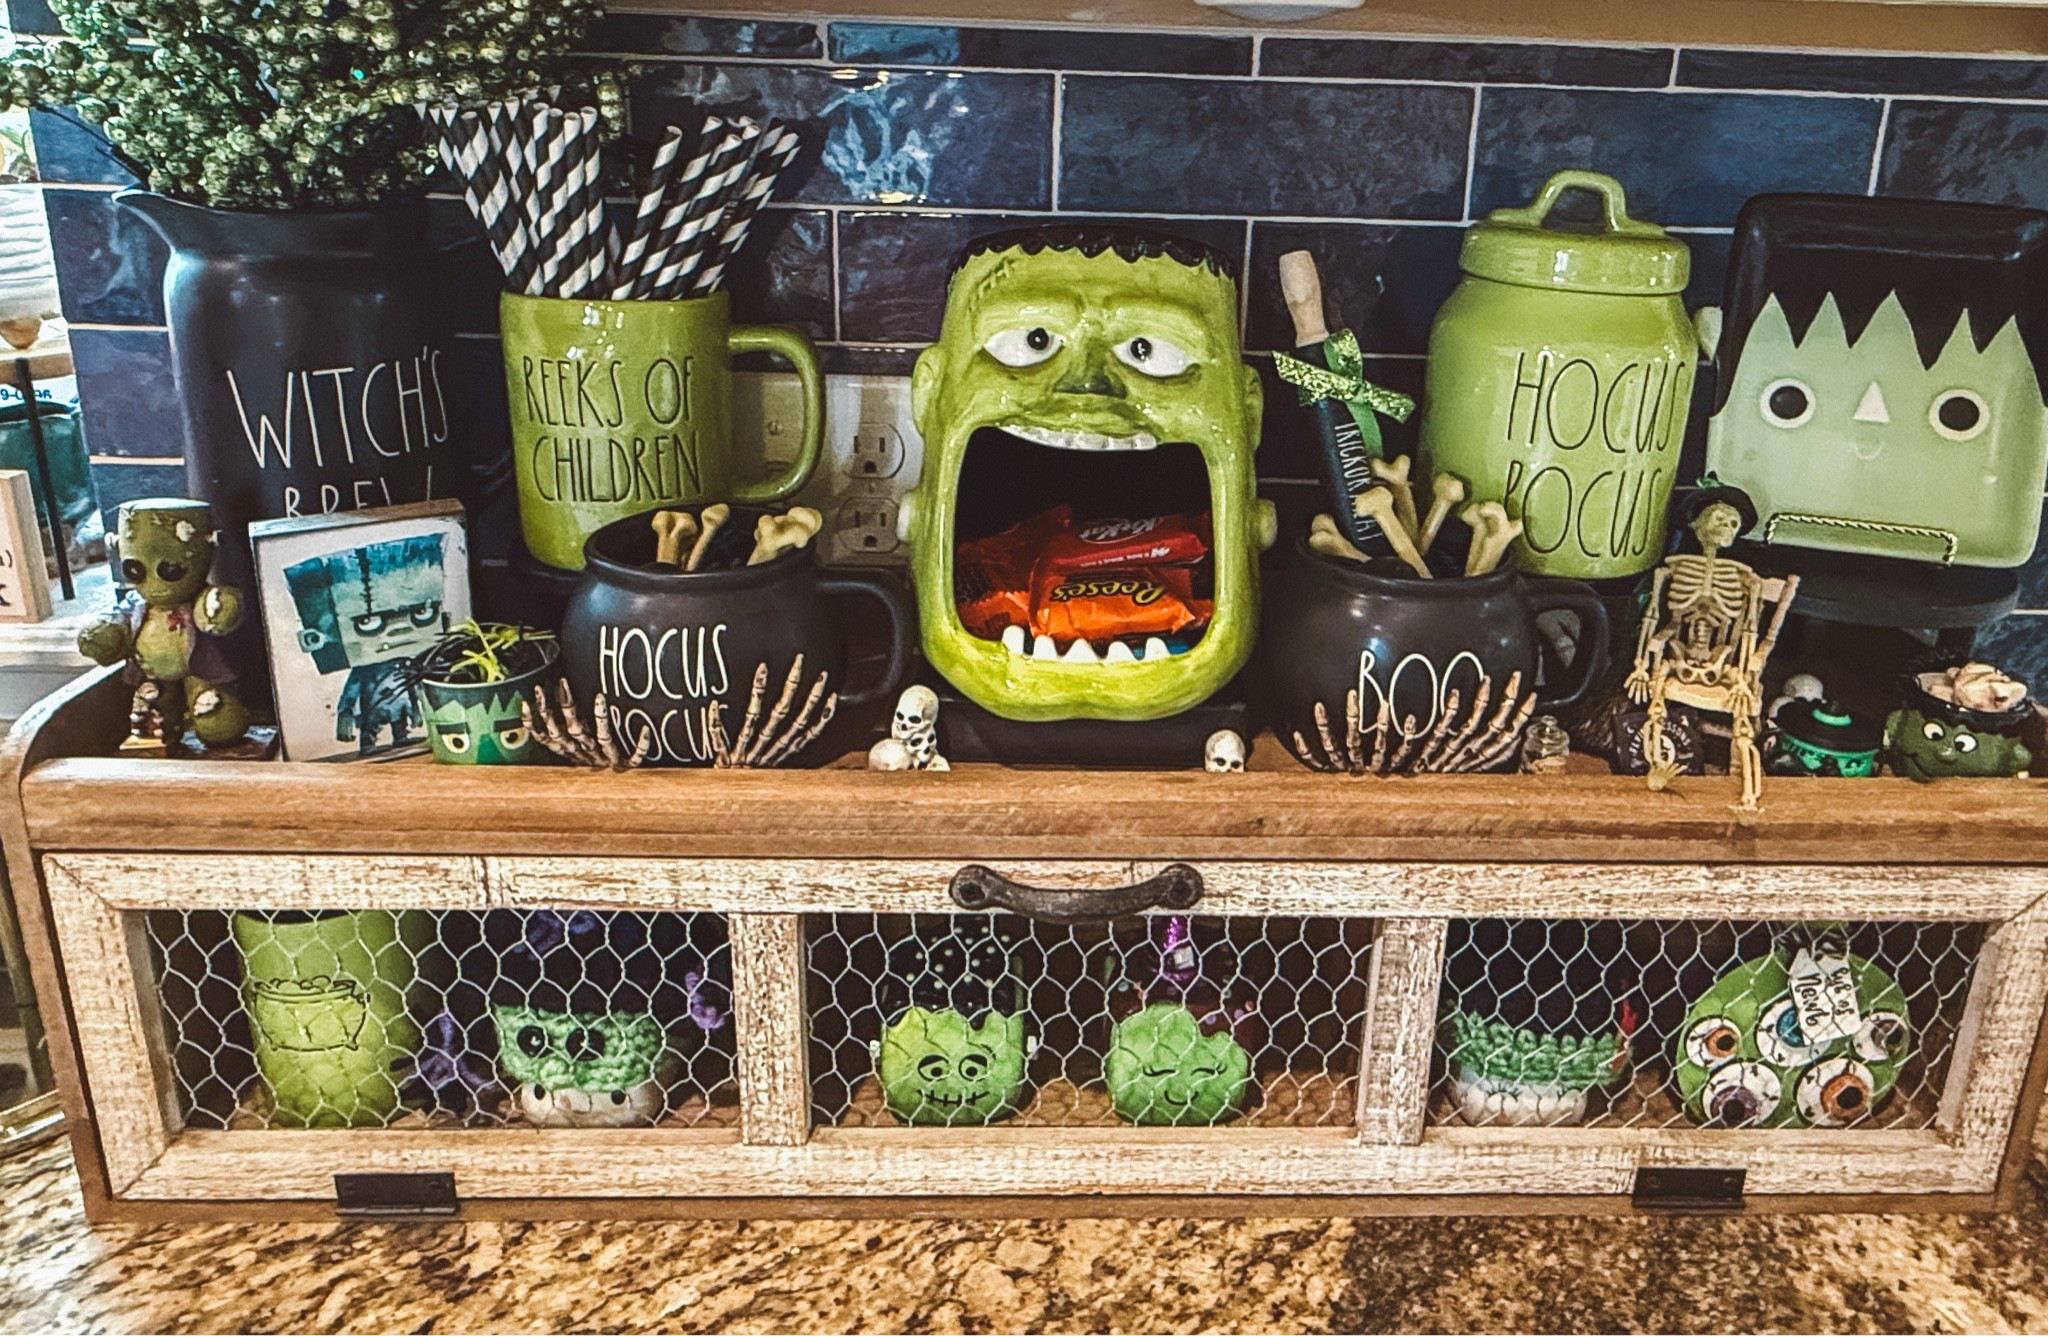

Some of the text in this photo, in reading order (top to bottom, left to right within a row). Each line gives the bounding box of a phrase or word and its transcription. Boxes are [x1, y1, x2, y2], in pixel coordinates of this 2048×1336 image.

[226, 345, 448, 469] WITCH'S
[523, 355, 694, 428] REEKS OF
[1507, 351, 1686, 454] HOCUS
[533, 431, 702, 502] CHILDREN
[1504, 459, 1663, 558] POCUS
[599, 623, 729, 700] HOCUS
[1358, 650, 1485, 739] BOO
